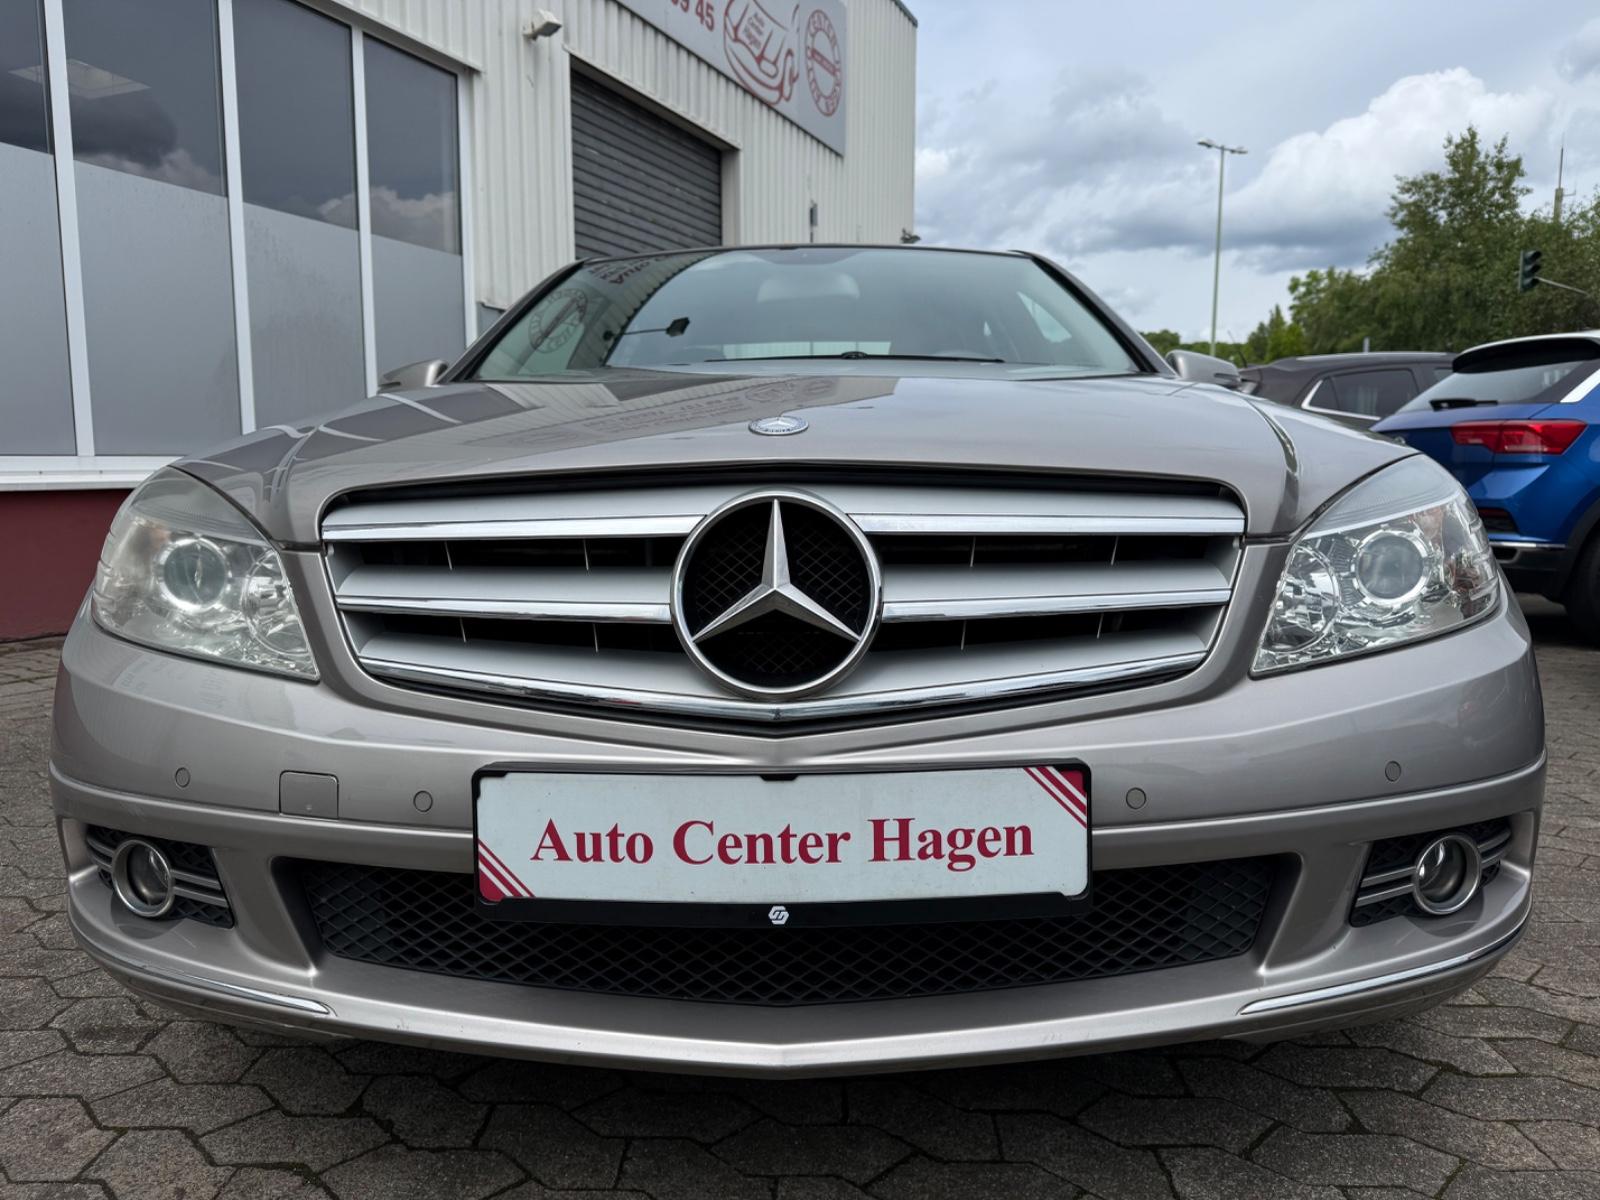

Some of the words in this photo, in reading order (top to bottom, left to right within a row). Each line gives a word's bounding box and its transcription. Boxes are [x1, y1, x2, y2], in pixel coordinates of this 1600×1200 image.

[695, 0, 714, 32] 45
[530, 818, 653, 864] Auto
[672, 820, 851, 865] Center
[867, 818, 1035, 871] Hagen
